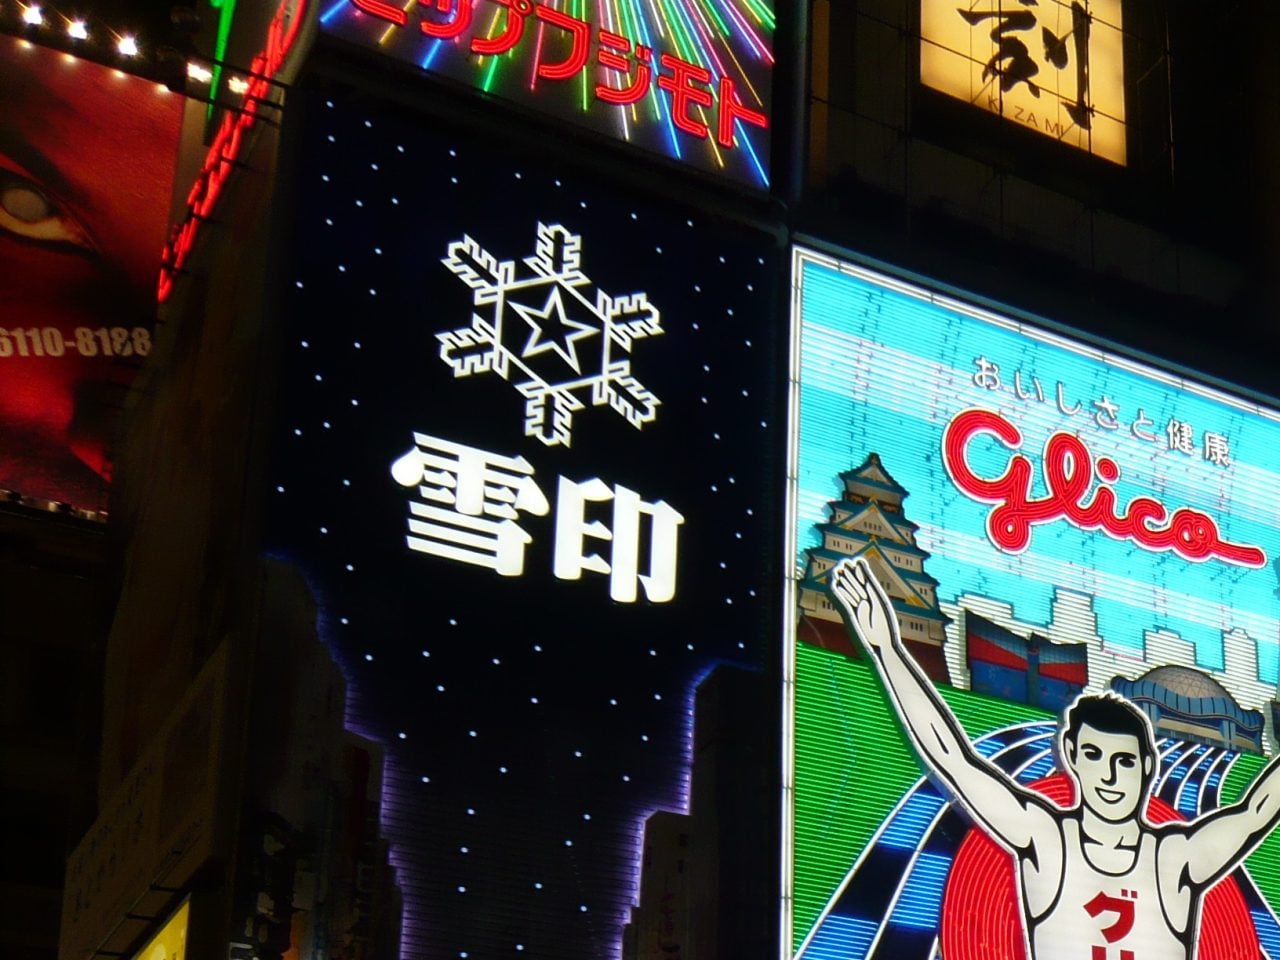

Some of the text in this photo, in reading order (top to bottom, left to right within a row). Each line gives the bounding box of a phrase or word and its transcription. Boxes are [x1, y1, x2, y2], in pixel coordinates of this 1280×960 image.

[942, 407, 1267, 568] Glico
[971, 356, 1231, 466] おいしさと健康
[391, 431, 685, 603] 雪印
